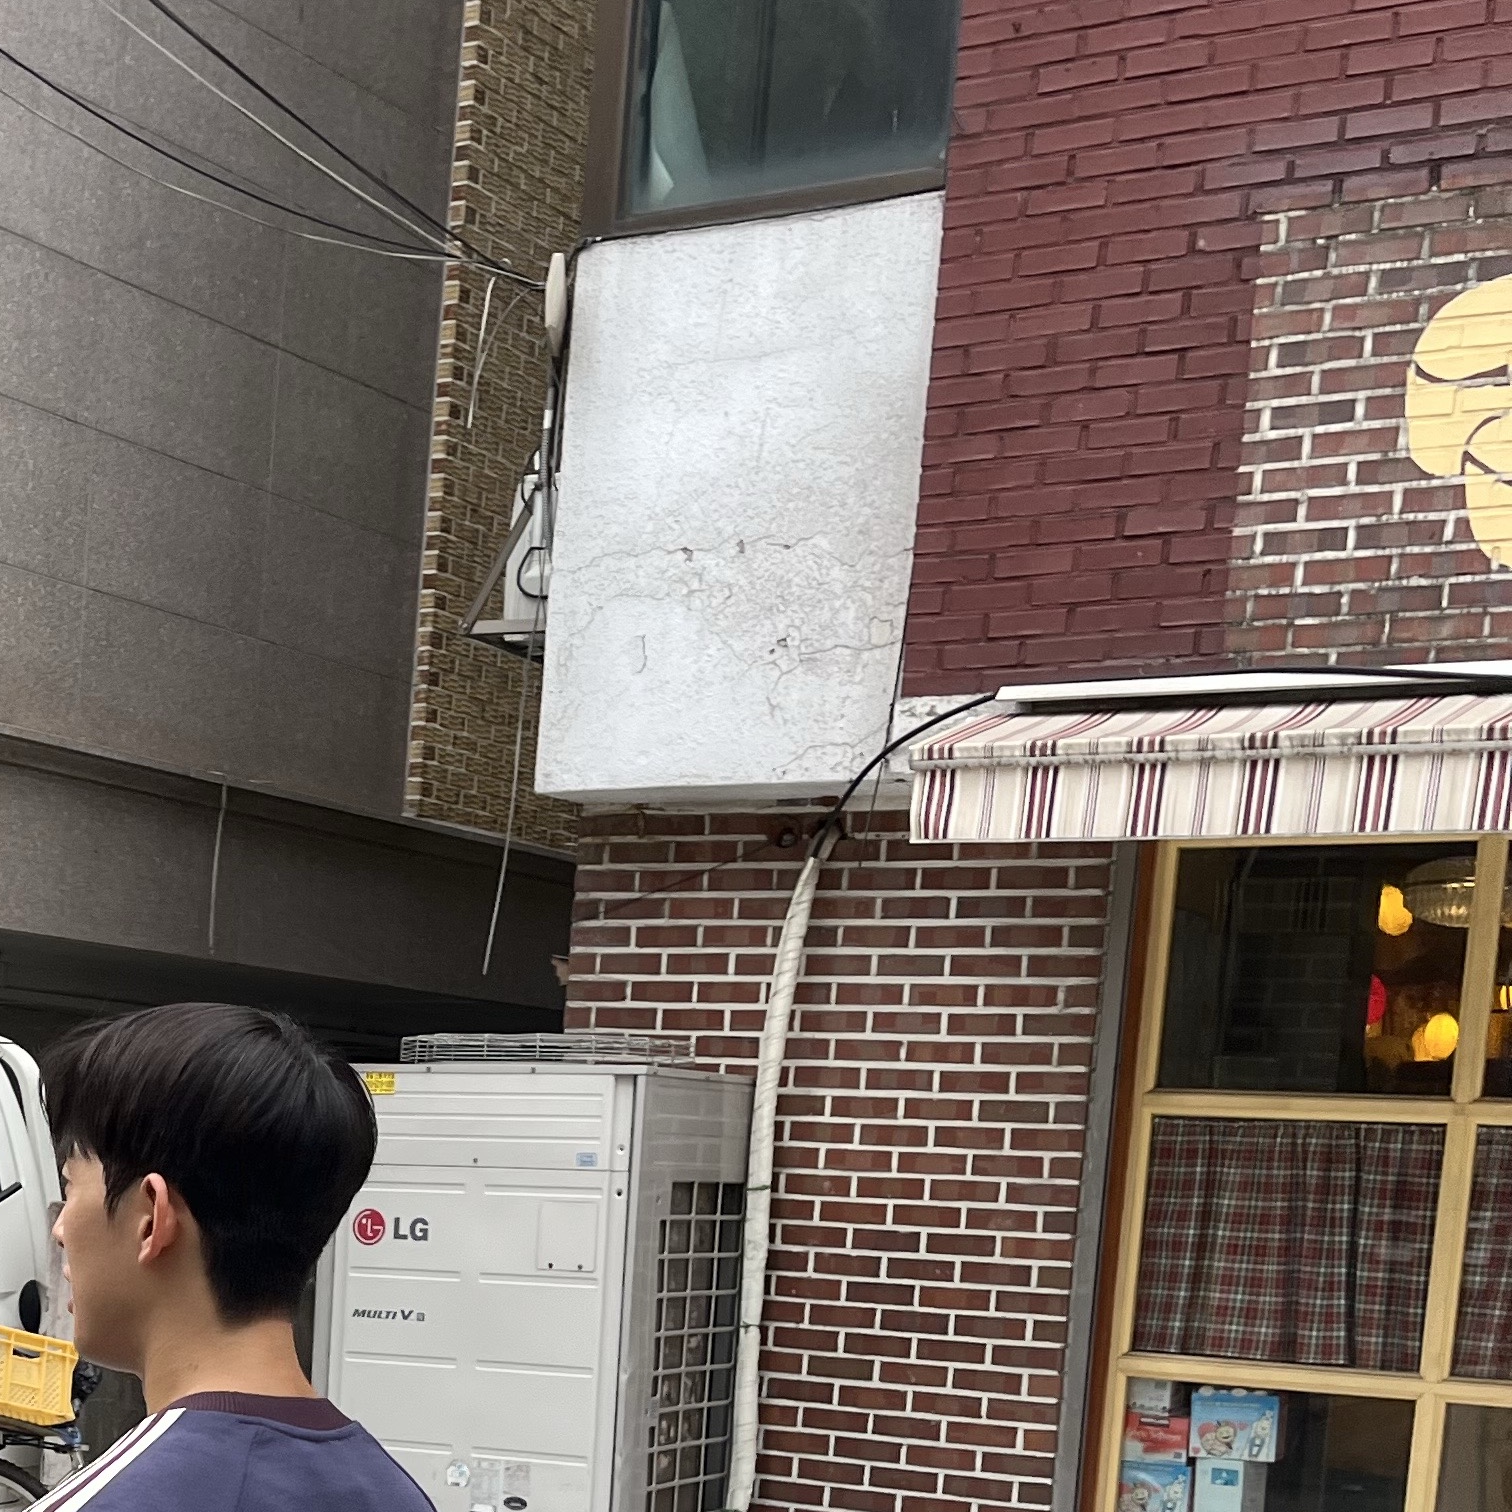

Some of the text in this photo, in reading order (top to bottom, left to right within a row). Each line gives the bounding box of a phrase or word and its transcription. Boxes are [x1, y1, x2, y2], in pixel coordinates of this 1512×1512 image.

[393, 1216, 429, 1241] LG
[352, 1308, 398, 1320] MULTI
[400, 1309, 415, 1321] V
